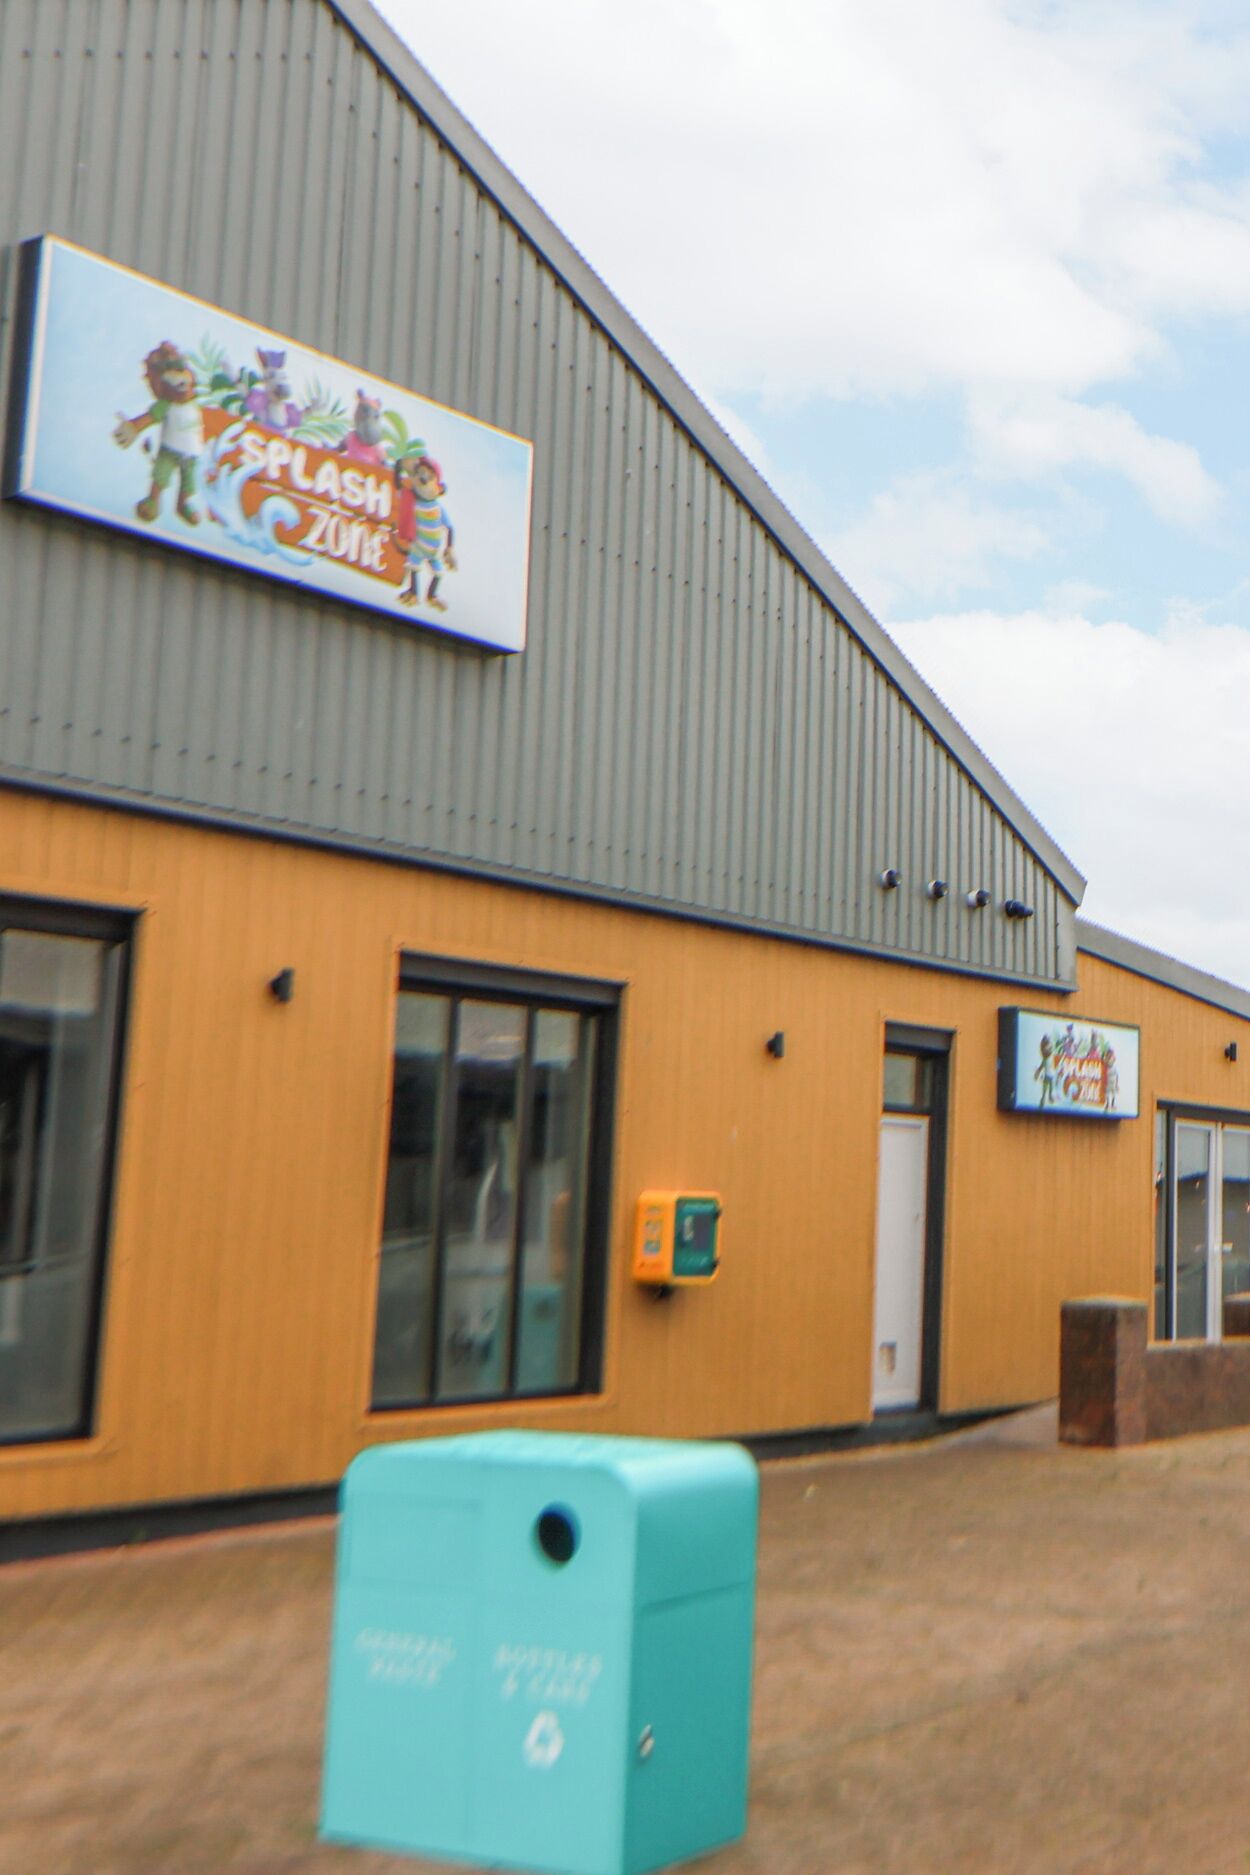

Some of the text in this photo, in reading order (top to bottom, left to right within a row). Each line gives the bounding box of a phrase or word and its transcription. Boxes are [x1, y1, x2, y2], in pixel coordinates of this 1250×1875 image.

[239, 429, 393, 520] SPLASH
[298, 505, 390, 573] ZONE
[1063, 1056, 1101, 1080] SPLASH
